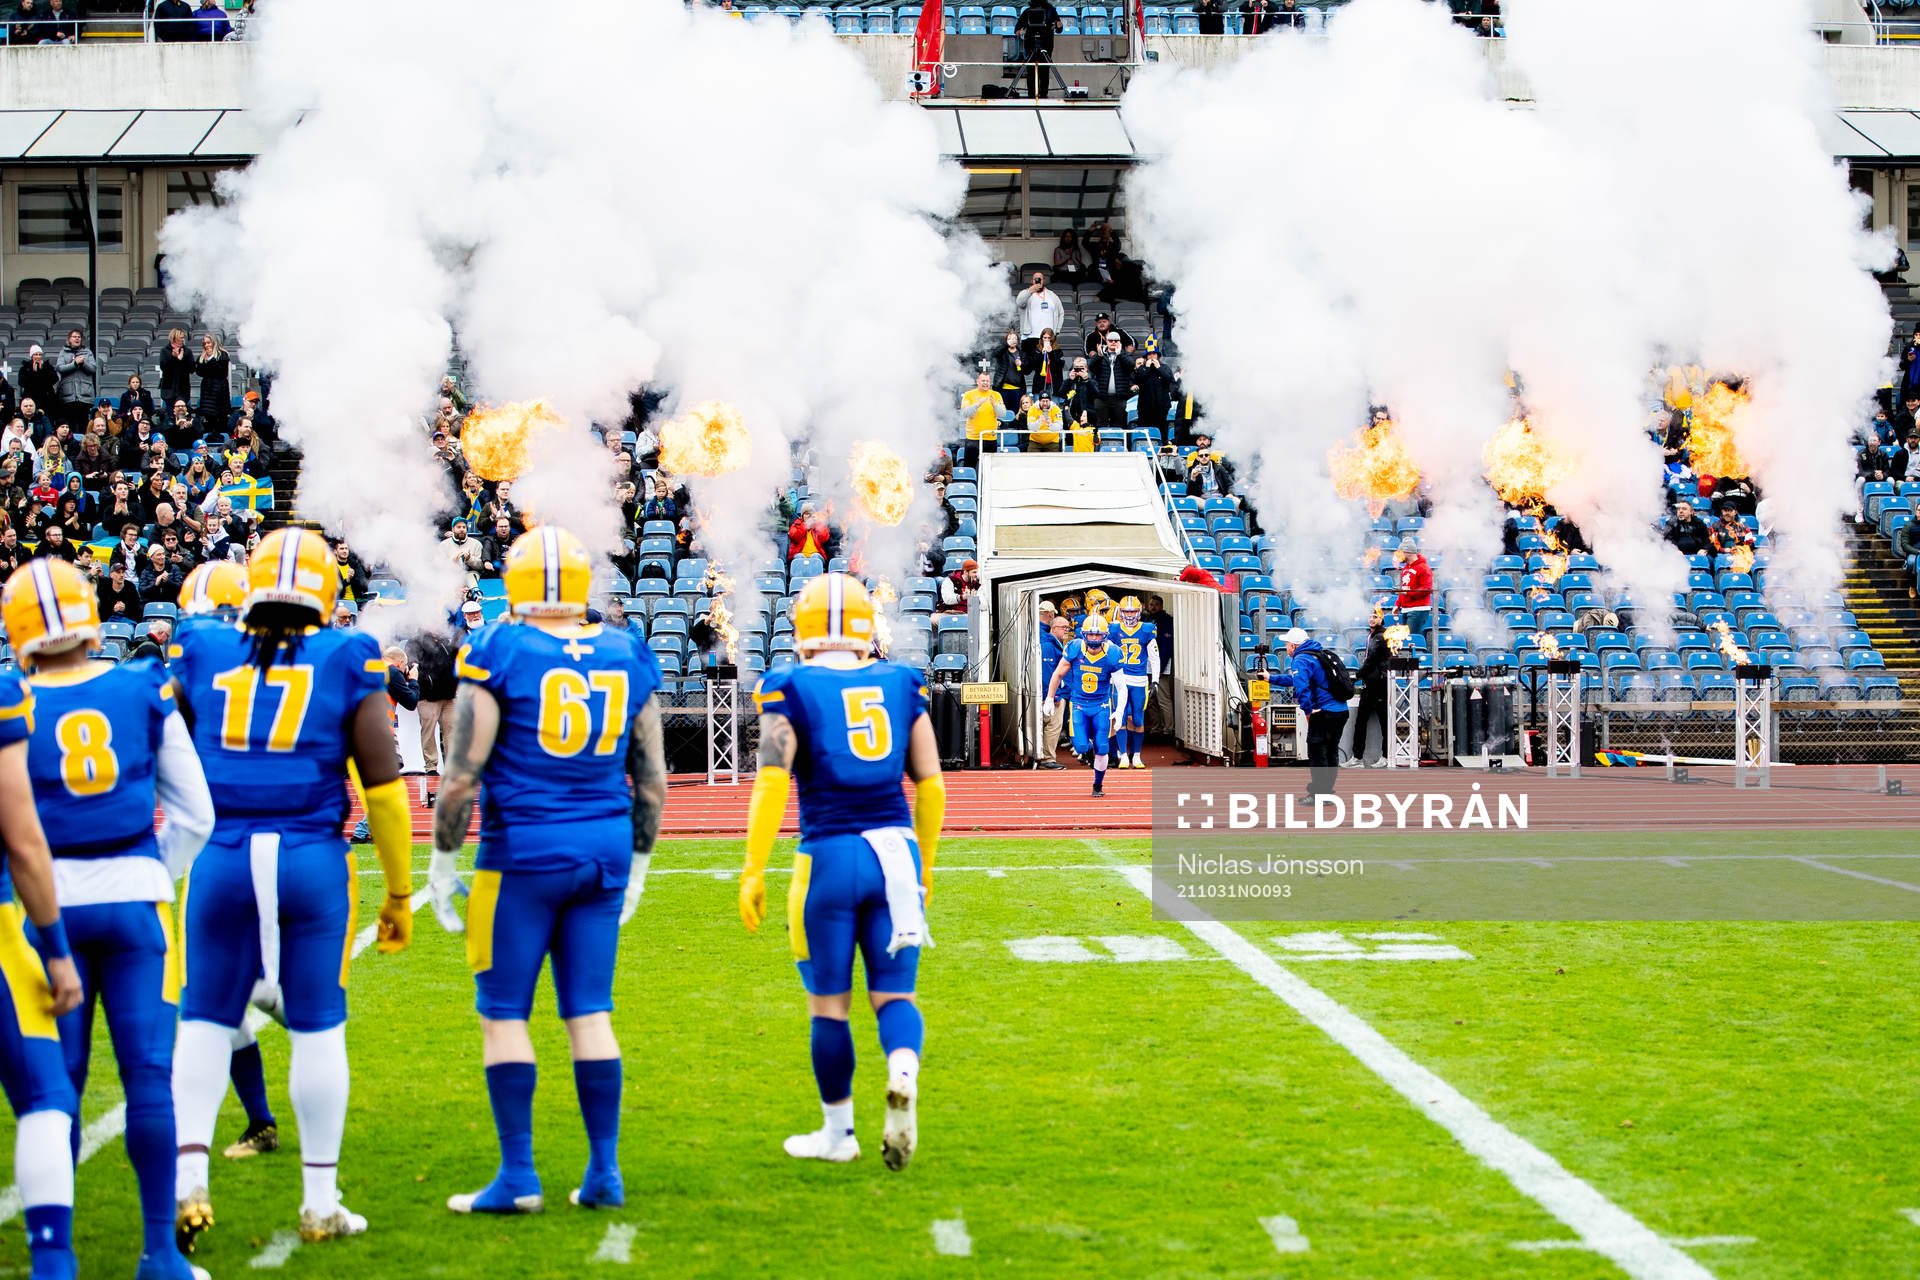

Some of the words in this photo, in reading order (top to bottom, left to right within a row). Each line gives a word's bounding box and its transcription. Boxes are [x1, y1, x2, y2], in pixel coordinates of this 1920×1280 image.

[55, 708, 120, 797] 8
[212, 665, 314, 752] 17
[537, 667, 629, 758] 67
[841, 686, 893, 761] 5
